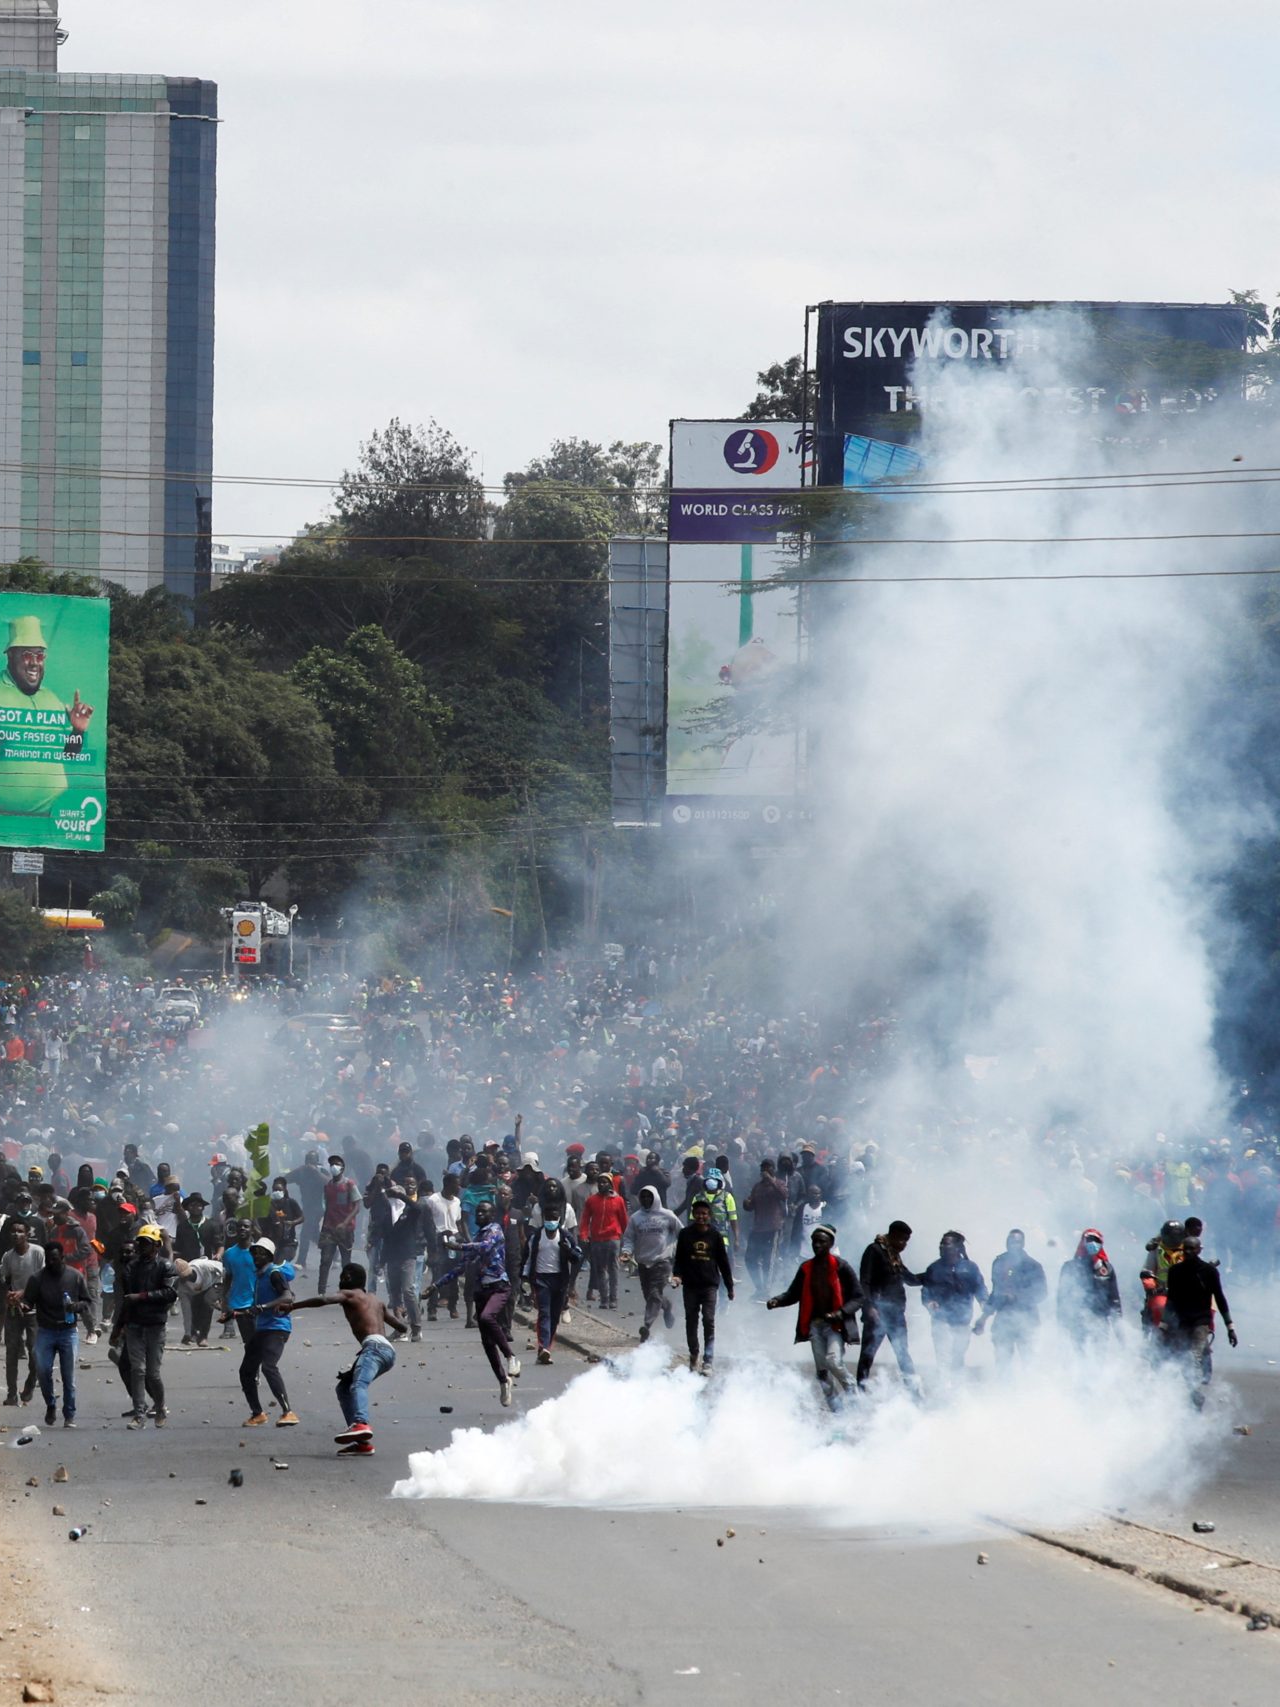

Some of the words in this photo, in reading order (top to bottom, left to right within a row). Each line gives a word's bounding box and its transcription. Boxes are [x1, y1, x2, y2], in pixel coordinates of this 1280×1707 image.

[842, 326, 1041, 360] SKYWORTH
[680, 503, 728, 516] WORLD
[731, 504, 774, 516] CLASS
[25, 711, 33, 723] A
[36, 712, 66, 725] PLAN
[23, 731, 56, 743] FASTER
[59, 733, 83, 745] THAN
[53, 751, 91, 762] WESTERN
[54, 819, 85, 832] YOUR
